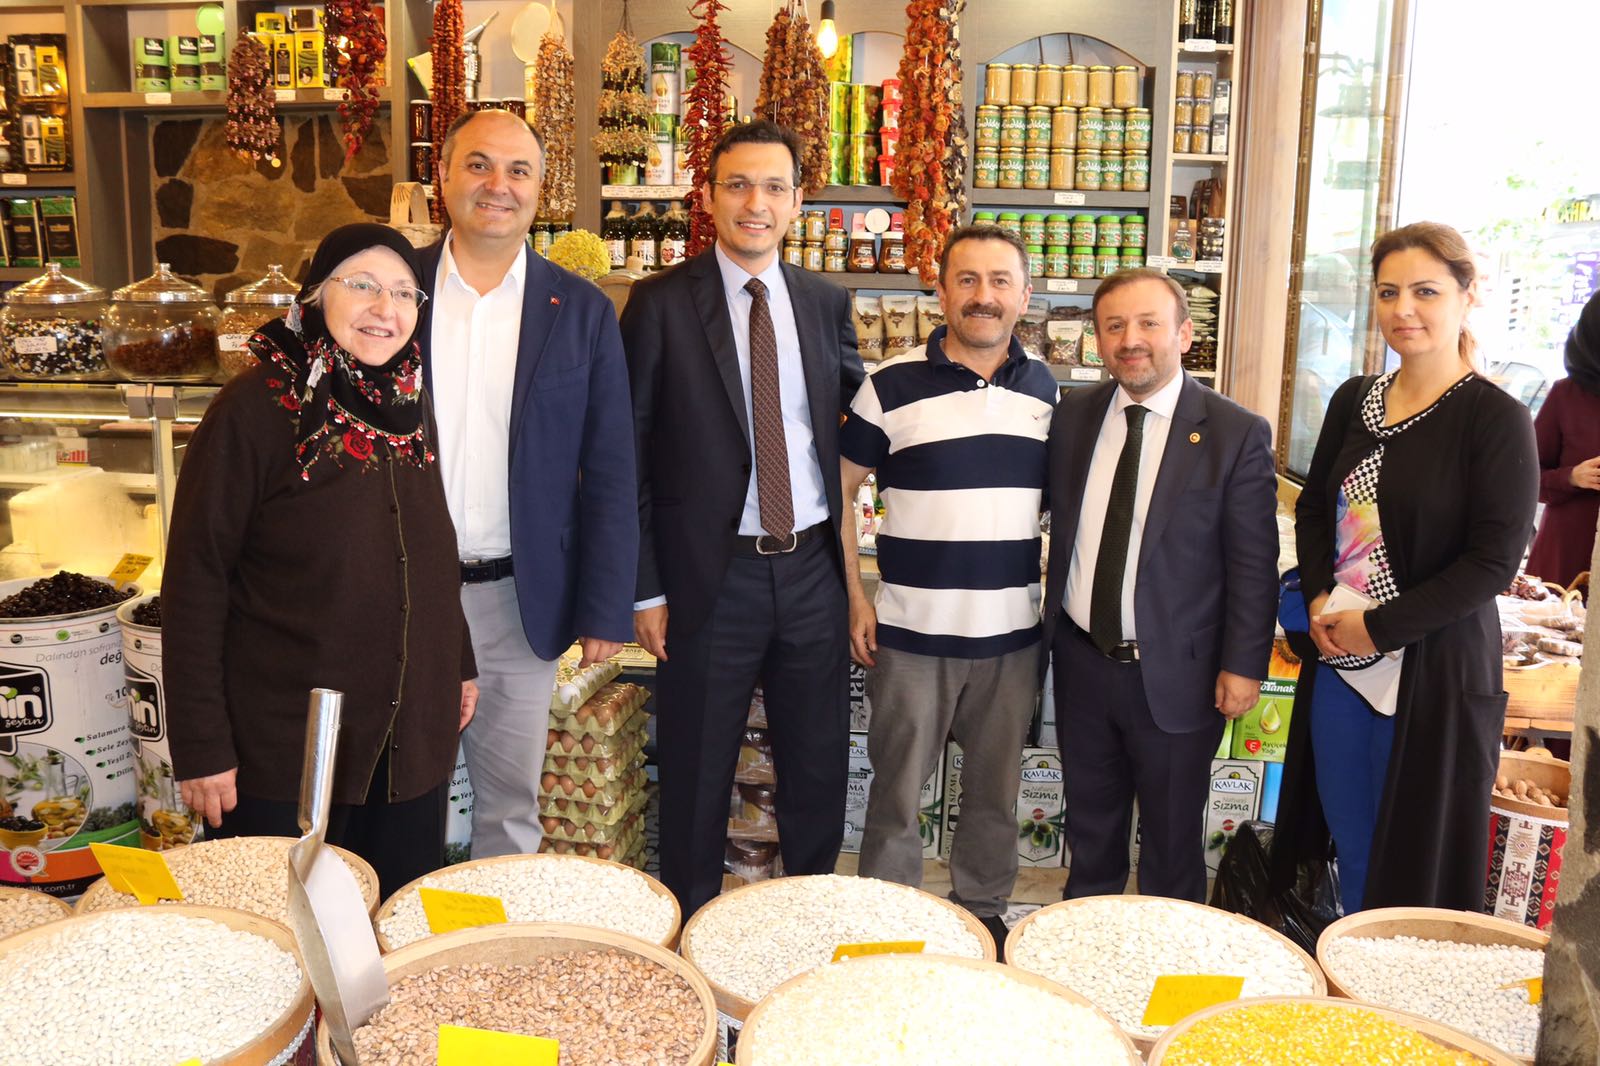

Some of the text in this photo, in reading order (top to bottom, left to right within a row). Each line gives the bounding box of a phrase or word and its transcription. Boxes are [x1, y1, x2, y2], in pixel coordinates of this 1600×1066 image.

[87, 725, 126, 741] Salamura
[97, 744, 114, 753] Sele
[1023, 769, 1061, 780] KAVLAK
[1214, 780, 1252, 791] KAVLAK
